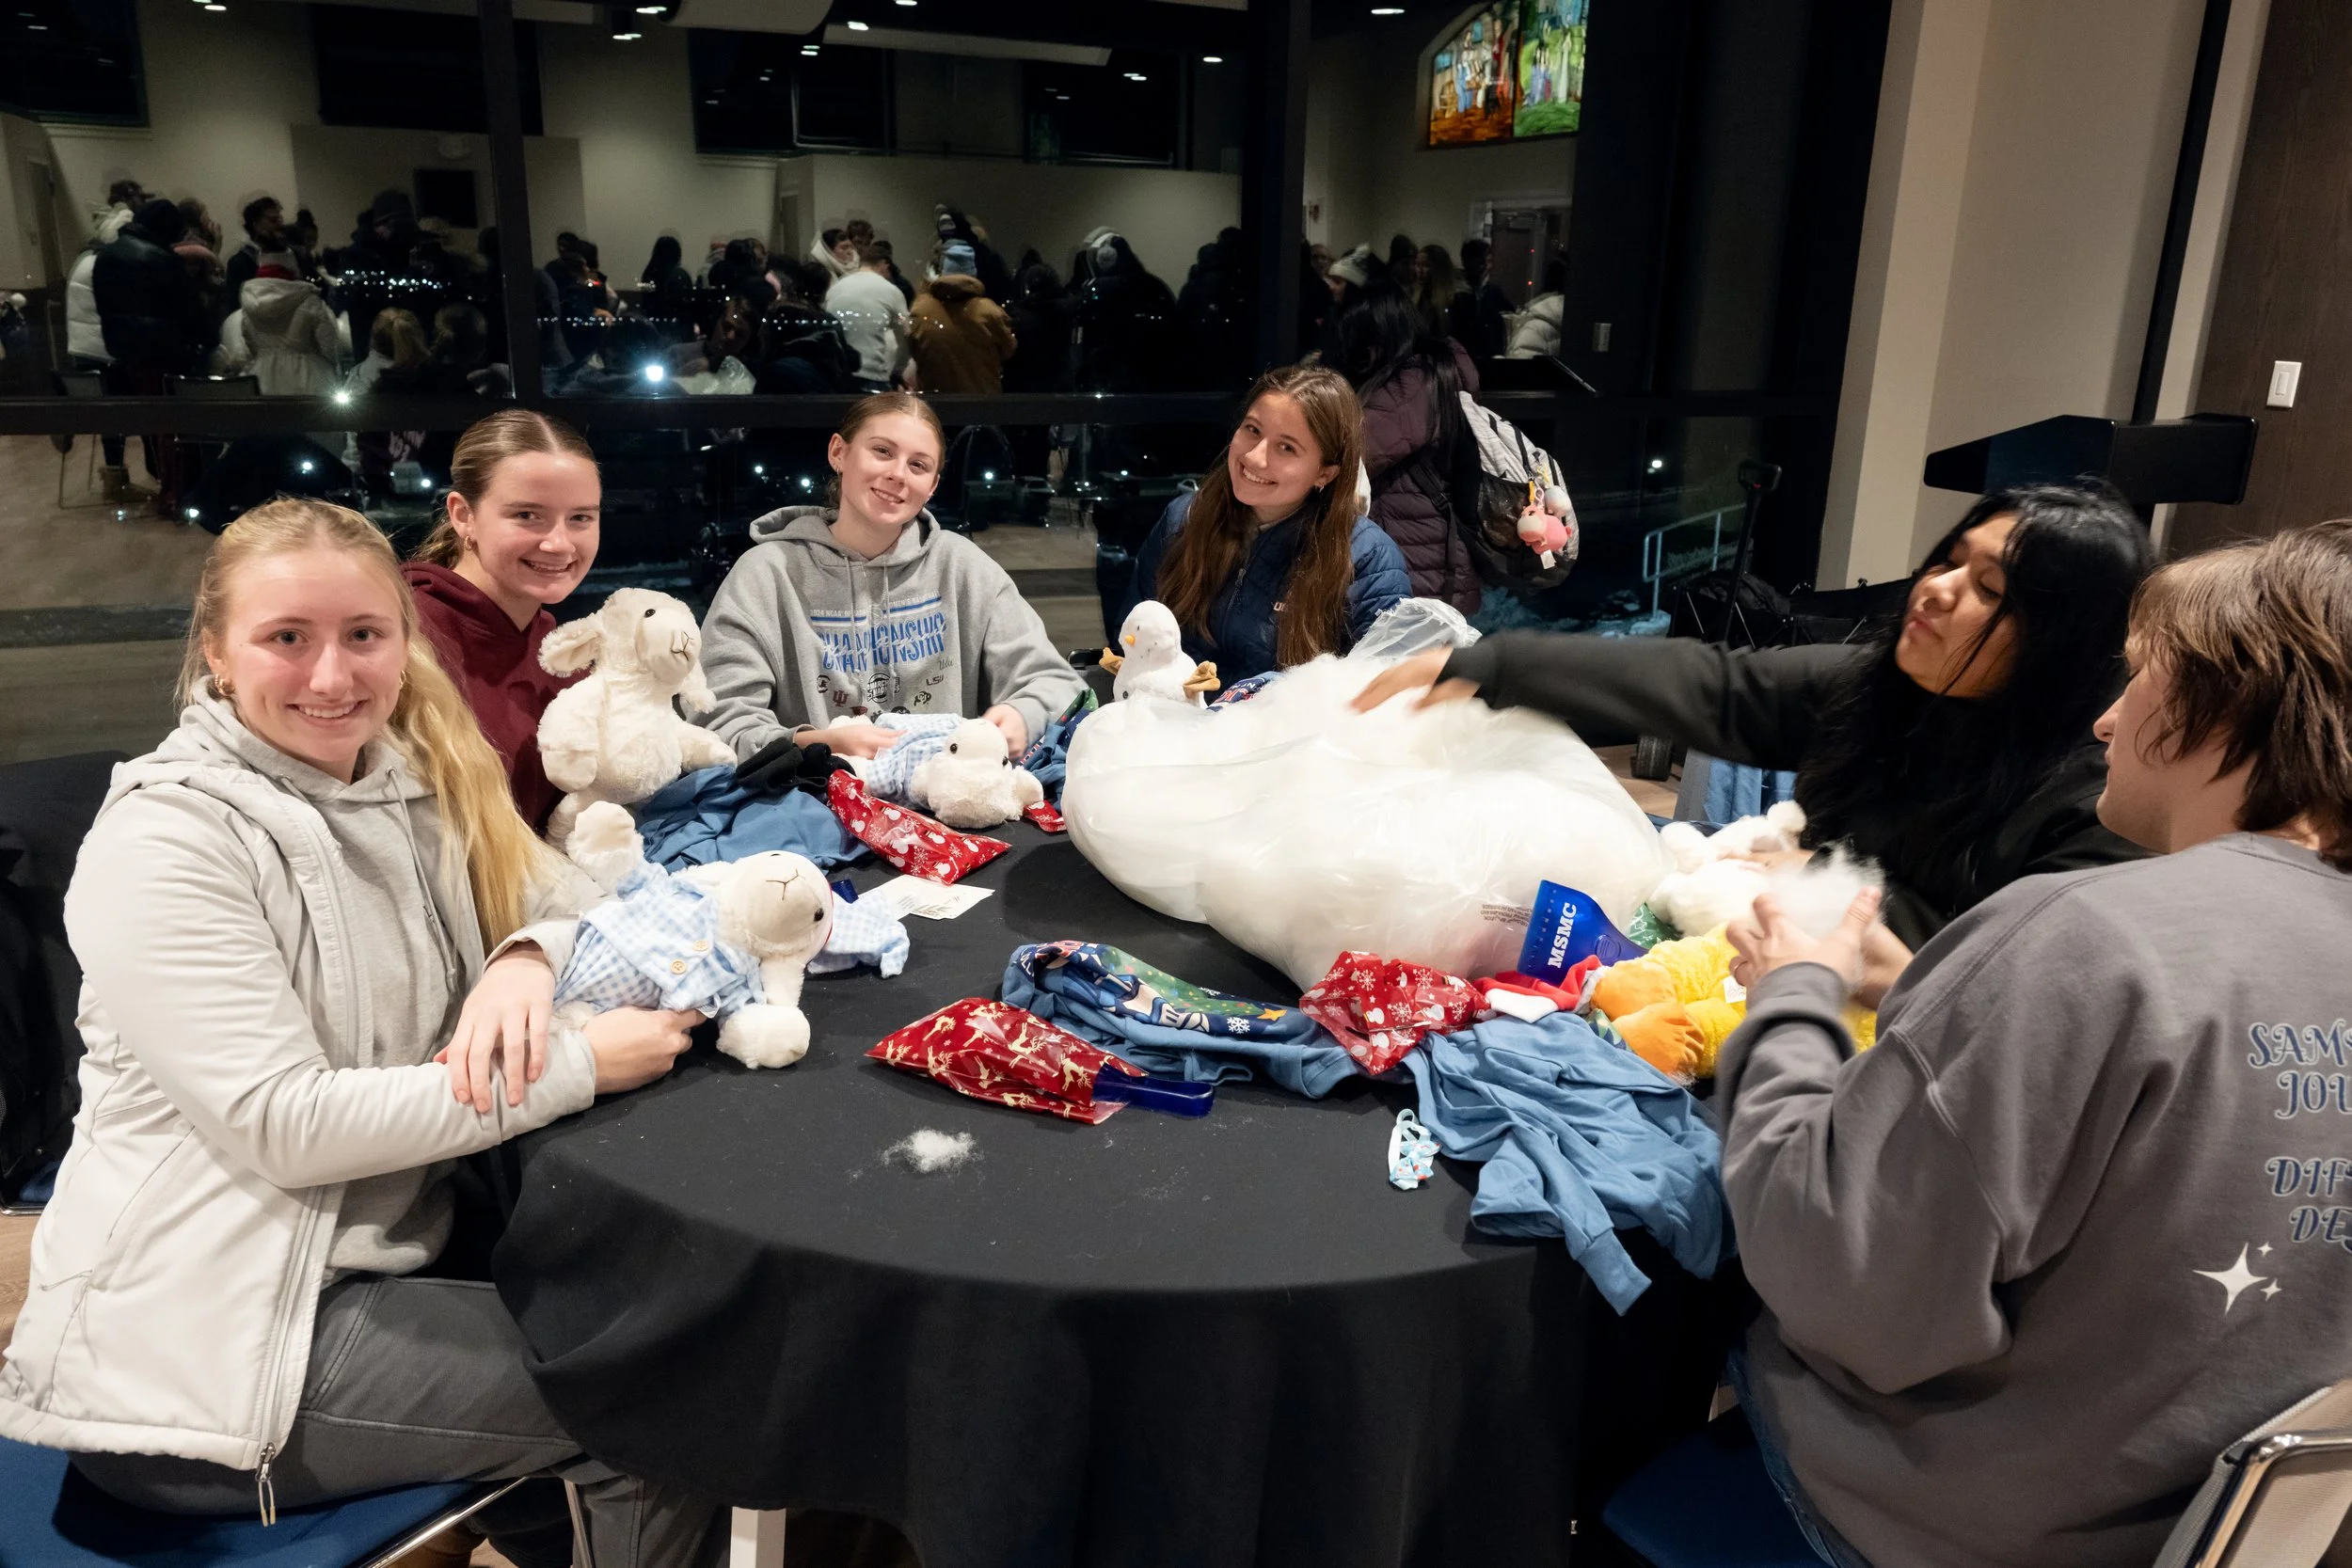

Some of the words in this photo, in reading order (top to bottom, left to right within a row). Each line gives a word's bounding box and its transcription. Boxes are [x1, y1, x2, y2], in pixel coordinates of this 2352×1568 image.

[1548, 902, 1577, 969] MSMC
[2265, 1156, 2352, 1197] DIF
[2289, 1206, 2352, 1253] DE
